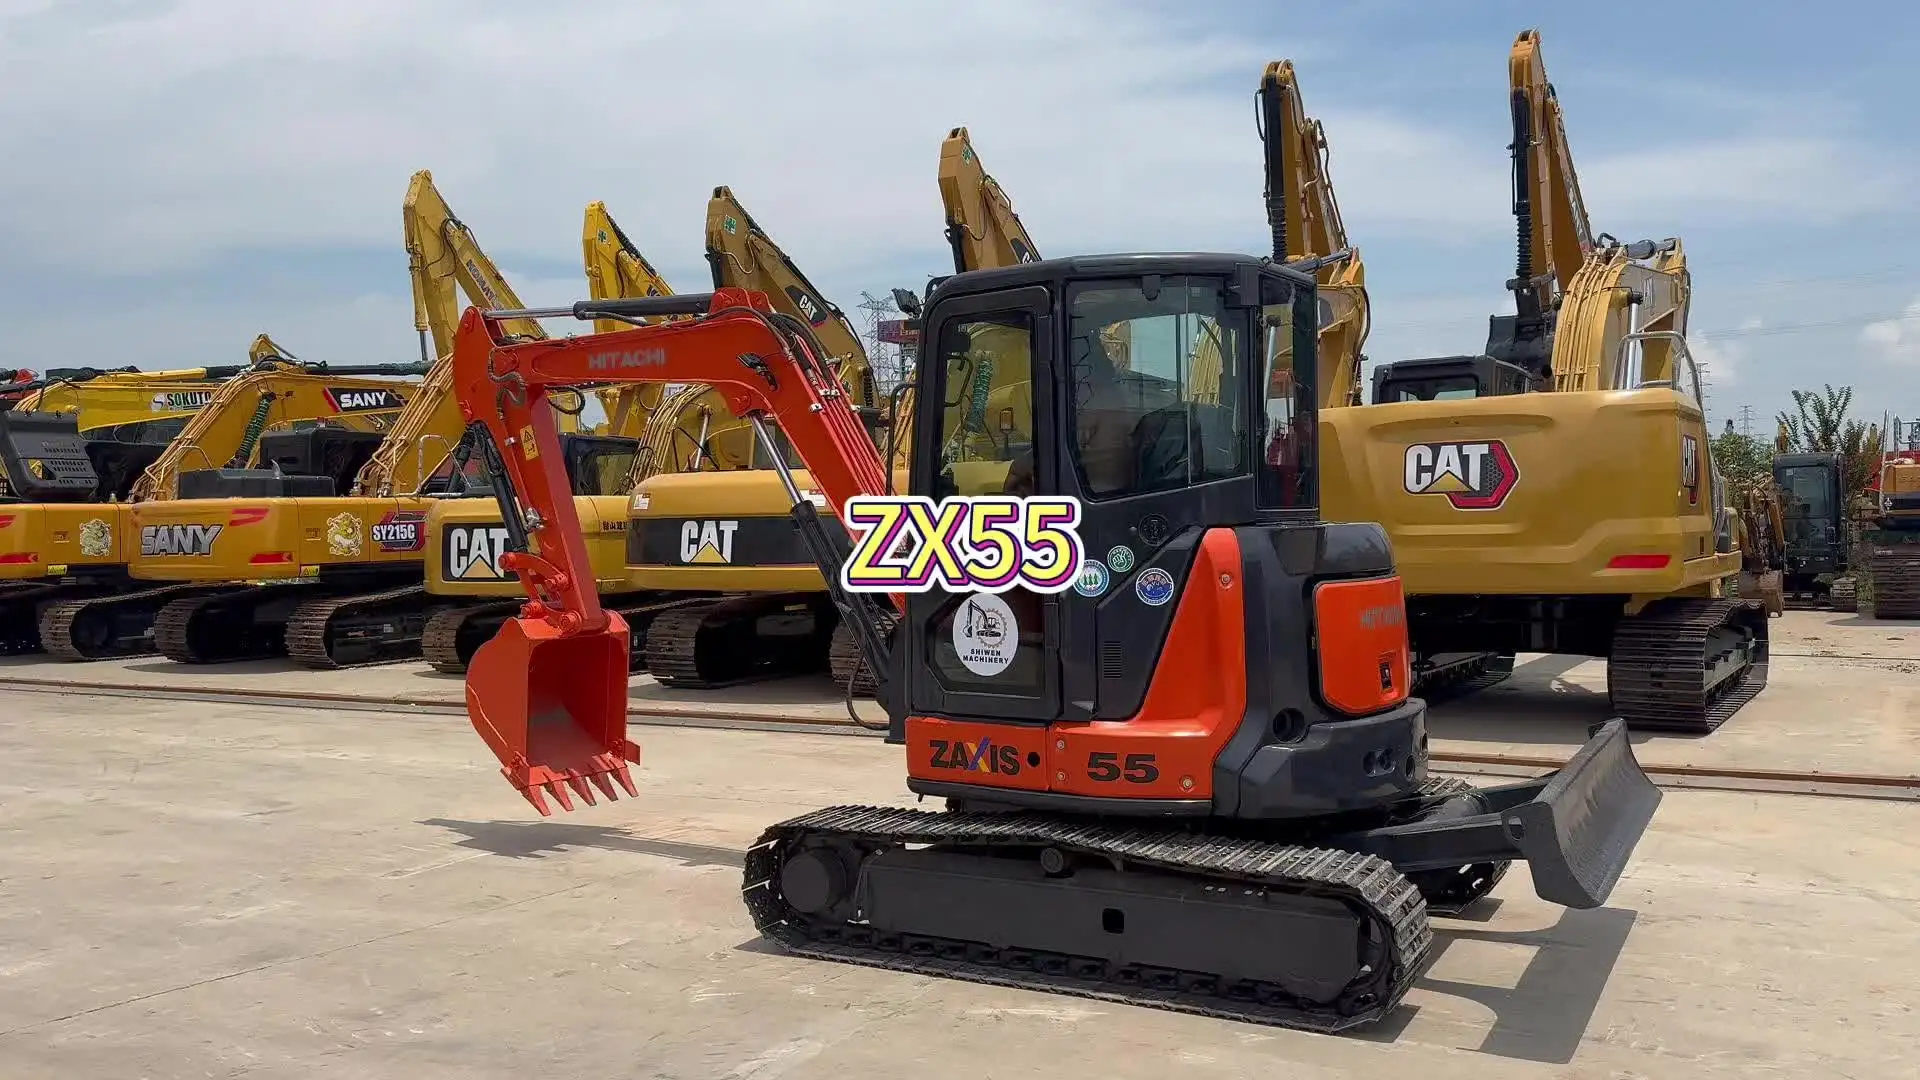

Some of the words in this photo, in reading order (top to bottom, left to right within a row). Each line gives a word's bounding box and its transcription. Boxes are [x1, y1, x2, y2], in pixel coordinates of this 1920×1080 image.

[799, 294, 817, 321] CAT
[588, 347, 666, 370] HITACHI
[340, 392, 386, 408] SANY
[1405, 443, 1489, 493] CAT
[140, 523, 223, 556] SANY
[372, 523, 415, 541] SY215C
[680, 520, 738, 563] CAT
[450, 527, 510, 578] CAT
[962, 655, 1009, 665] MACHINERY
[970, 648, 1001, 656] SHIWEN
[929, 736, 1021, 776] ZAXIS
[1087, 751, 1160, 784] 55
